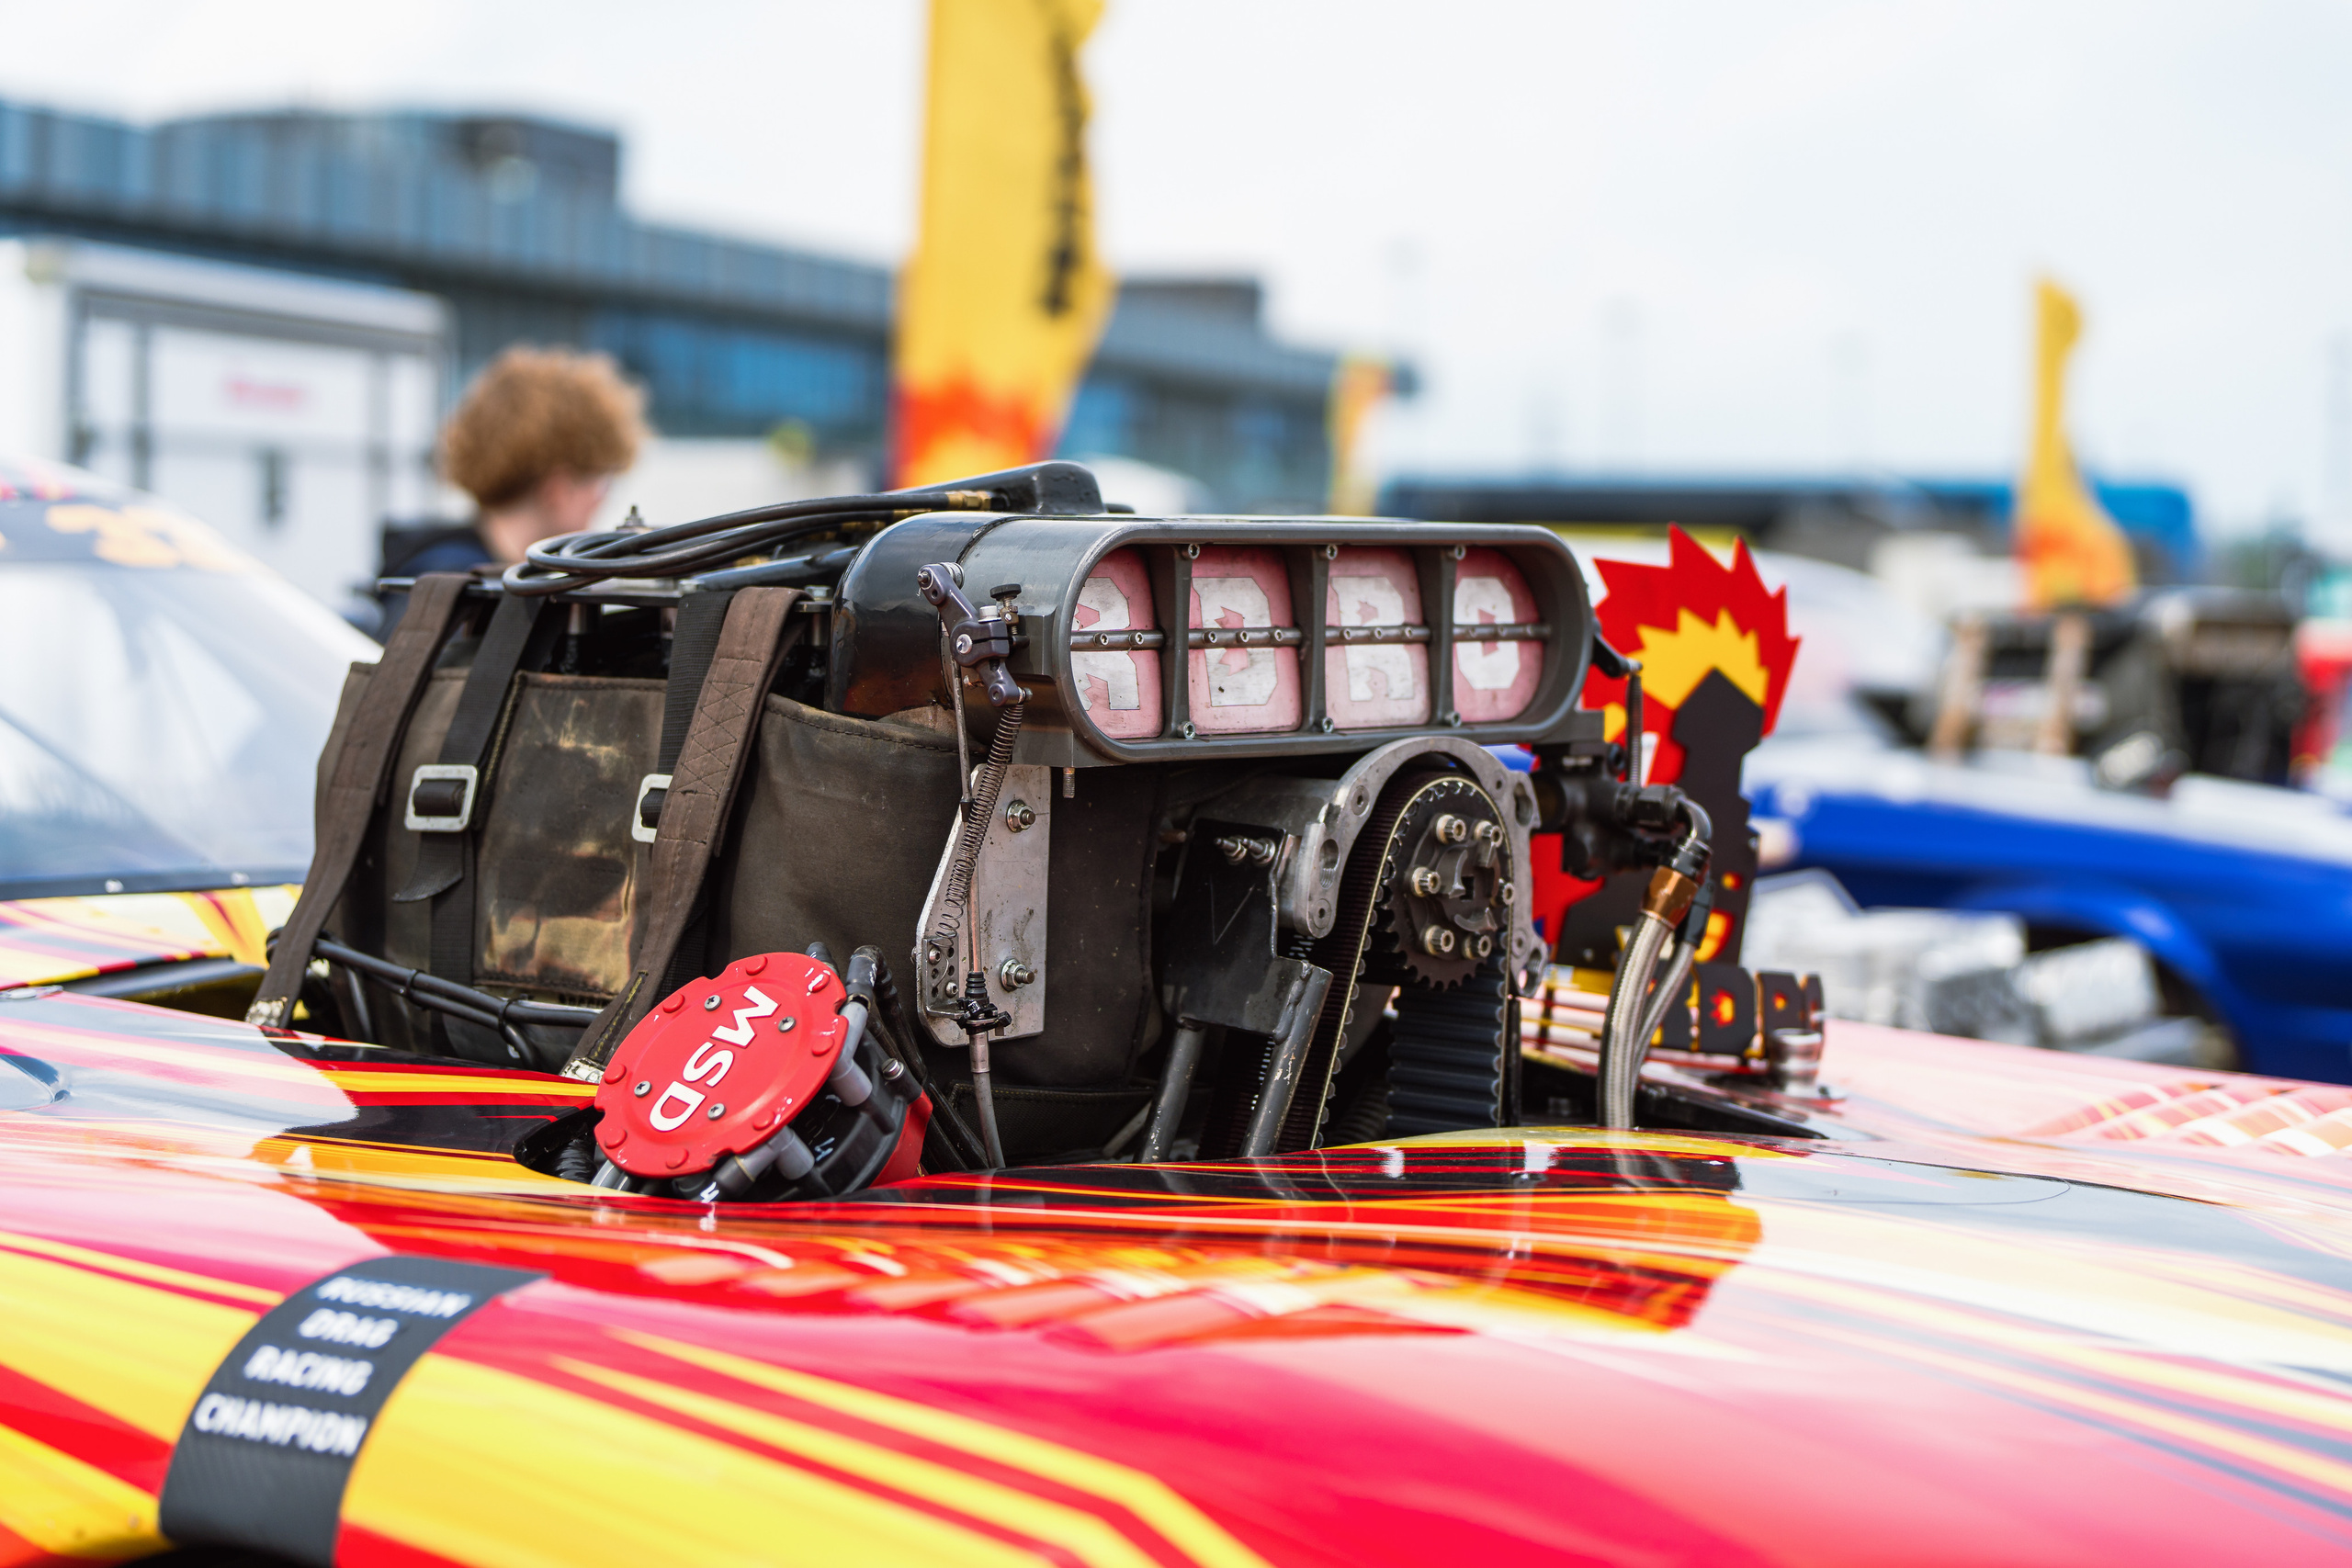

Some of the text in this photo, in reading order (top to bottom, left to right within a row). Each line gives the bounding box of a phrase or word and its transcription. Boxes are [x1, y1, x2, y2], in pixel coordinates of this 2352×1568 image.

[649, 986, 780, 1131] MSD
[317, 1276, 472, 1318] RUSSIAN
[299, 1307, 400, 1348] DRAG
[243, 1344, 374, 1396] RACING
[193, 1392, 368, 1457] CHAMPION
